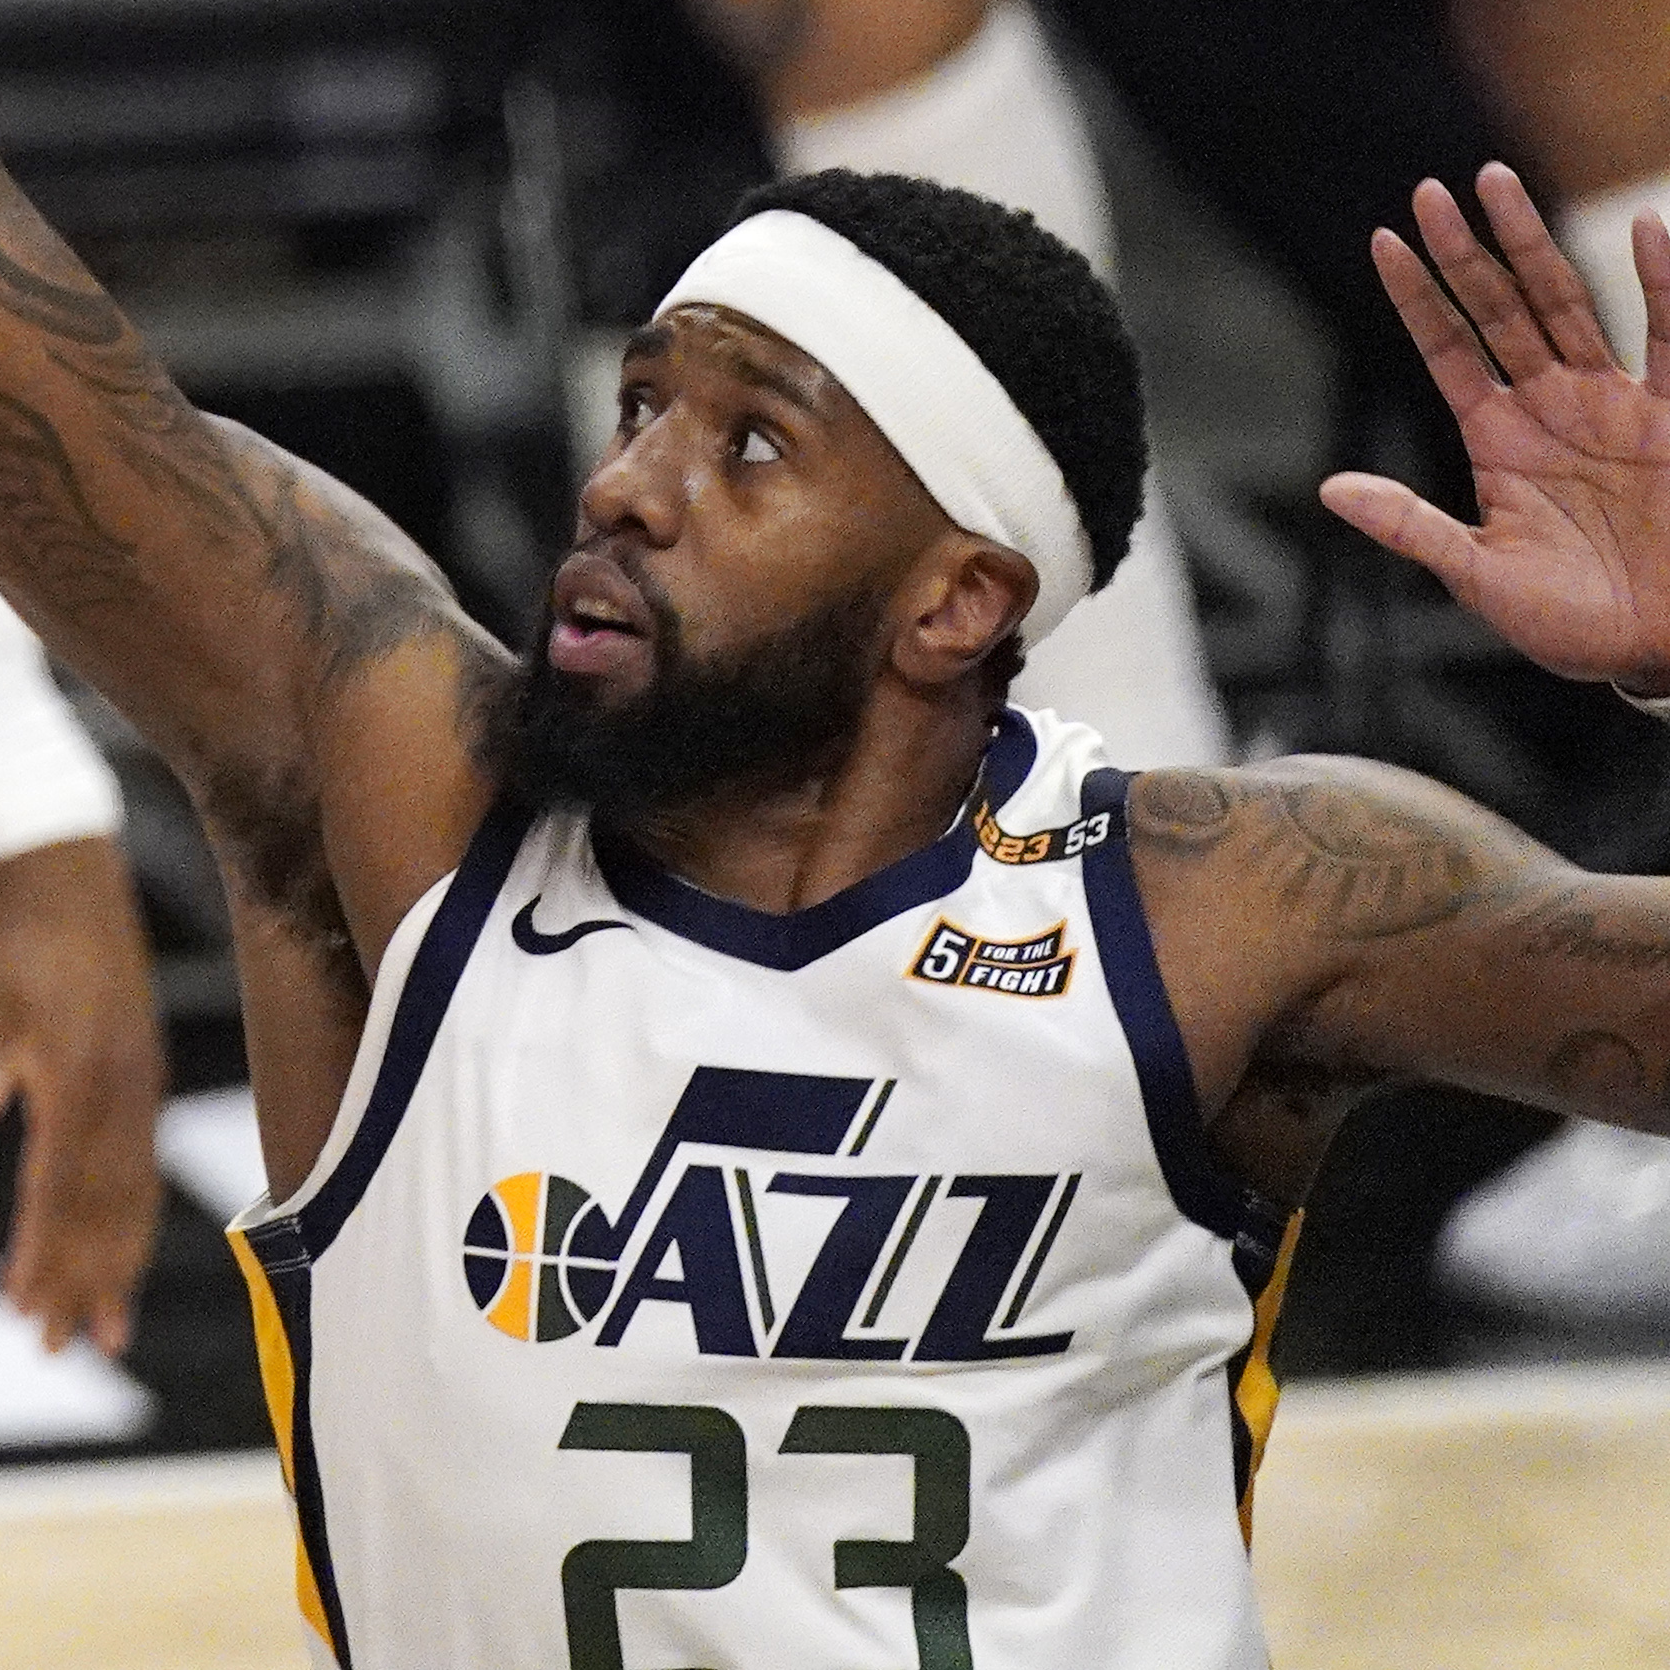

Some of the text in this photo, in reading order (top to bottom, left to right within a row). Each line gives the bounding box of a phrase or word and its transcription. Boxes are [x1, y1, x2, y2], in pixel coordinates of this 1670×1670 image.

[1064, 812, 1110, 854] 53
[922, 929, 968, 980] 5
[982, 936, 1055, 961] FOR THE
[970, 964, 1064, 993] FIGHT
[463, 1065, 1083, 1362] JAZZ
[557, 1401, 974, 1670] 23
